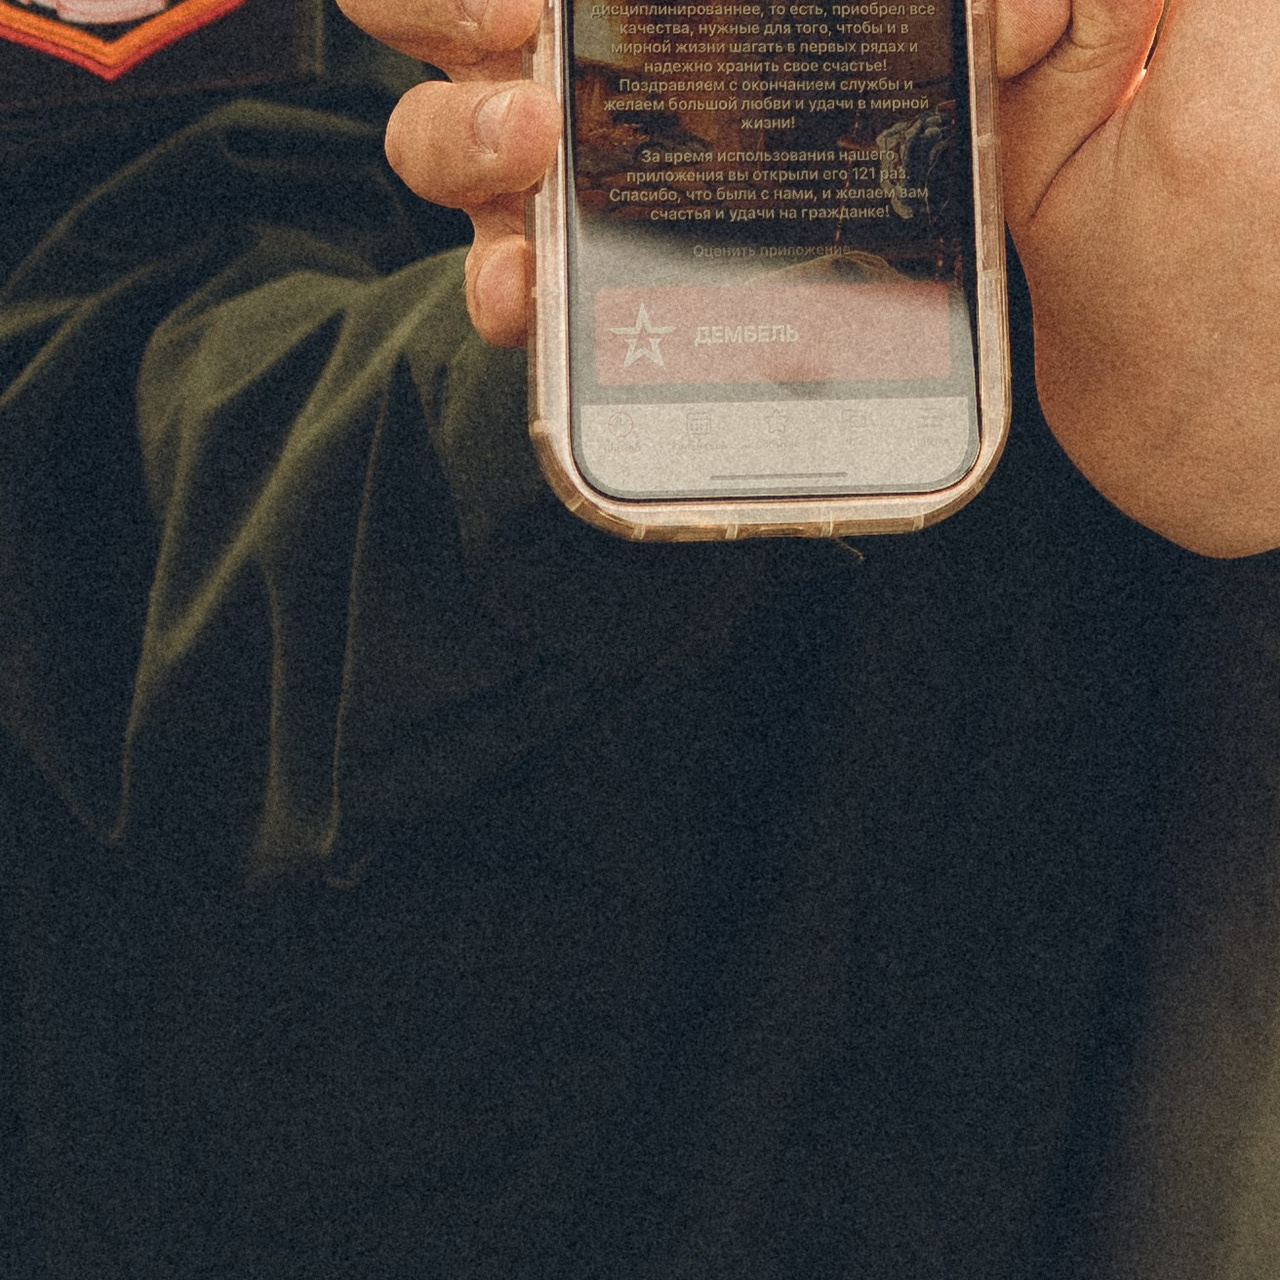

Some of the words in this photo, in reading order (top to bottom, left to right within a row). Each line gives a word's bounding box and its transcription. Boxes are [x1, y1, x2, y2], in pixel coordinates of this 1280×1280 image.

[590, 5, 765, 18] дисциплинированнее,
[769, 5, 784, 14] то
[790, 5, 827, 17] есть,
[832, 2, 905, 17] приобрел
[910, 5, 935, 14] все
[619, 24, 694, 37] качества,
[698, 24, 759, 37] нужные
[763, 24, 792, 36] для
[796, 24, 831, 37] того,
[837, 21, 882, 33] чтобы
[887, 24, 896, 33] и
[900, 24, 909, 33] в
[611, 39, 671, 56] мирной
[675, 42, 724, 53] жизни
[729, 42, 783, 53] шагать
[788, 42, 795, 53] в
[800, 42, 855, 55] первых
[861, 42, 905, 55] рядах
[909, 42, 918, 52] и
[644, 62, 712, 74] надежно
[718, 61, 779, 75] хранить
[783, 61, 818, 71] свое
[823, 58, 887, 71] счастье!
[619, 78, 724, 94] Поздравляем
[729, 81, 737, 91] с
[742, 81, 835, 91] окончанием
[840, 77, 899, 94] службы
[904, 80, 913, 91] и
[604, 100, 664, 110] желаем
[669, 96, 736, 110] большой
[741, 96, 790, 109] любви
[795, 99, 804, 109] и
[809, 99, 853, 112] удачи
[858, 99, 866, 109] в
[871, 95, 929, 112] мирной
[741, 116, 795, 129] жизни!
[641, 150, 660, 163] За
[664, 153, 713, 165] время
[718, 152, 834, 162] использования
[839, 151, 895, 161] нашего
[627, 171, 724, 184] приложения
[729, 171, 749, 181] вы
[754, 171, 818, 184] открыли
[823, 170, 848, 180] его
[853, 167, 876, 180] 121
[610, 188, 682, 203] Спасибо,
[686, 190, 712, 200] что
[716, 187, 756, 200] были
[761, 190, 769, 200] с
[774, 190, 817, 202] нами,
[822, 189, 831, 199] и
[836, 189, 895, 199] желаем
[900, 189, 929, 199] вам
[650, 210, 710, 220] счастья
[715, 210, 724, 219] и
[729, 209, 774, 222] удачи
[779, 209, 797, 219] на
[801, 206, 890, 221] гражданке!
[694, 324, 799, 346] ДЕМБЕЛЬ
